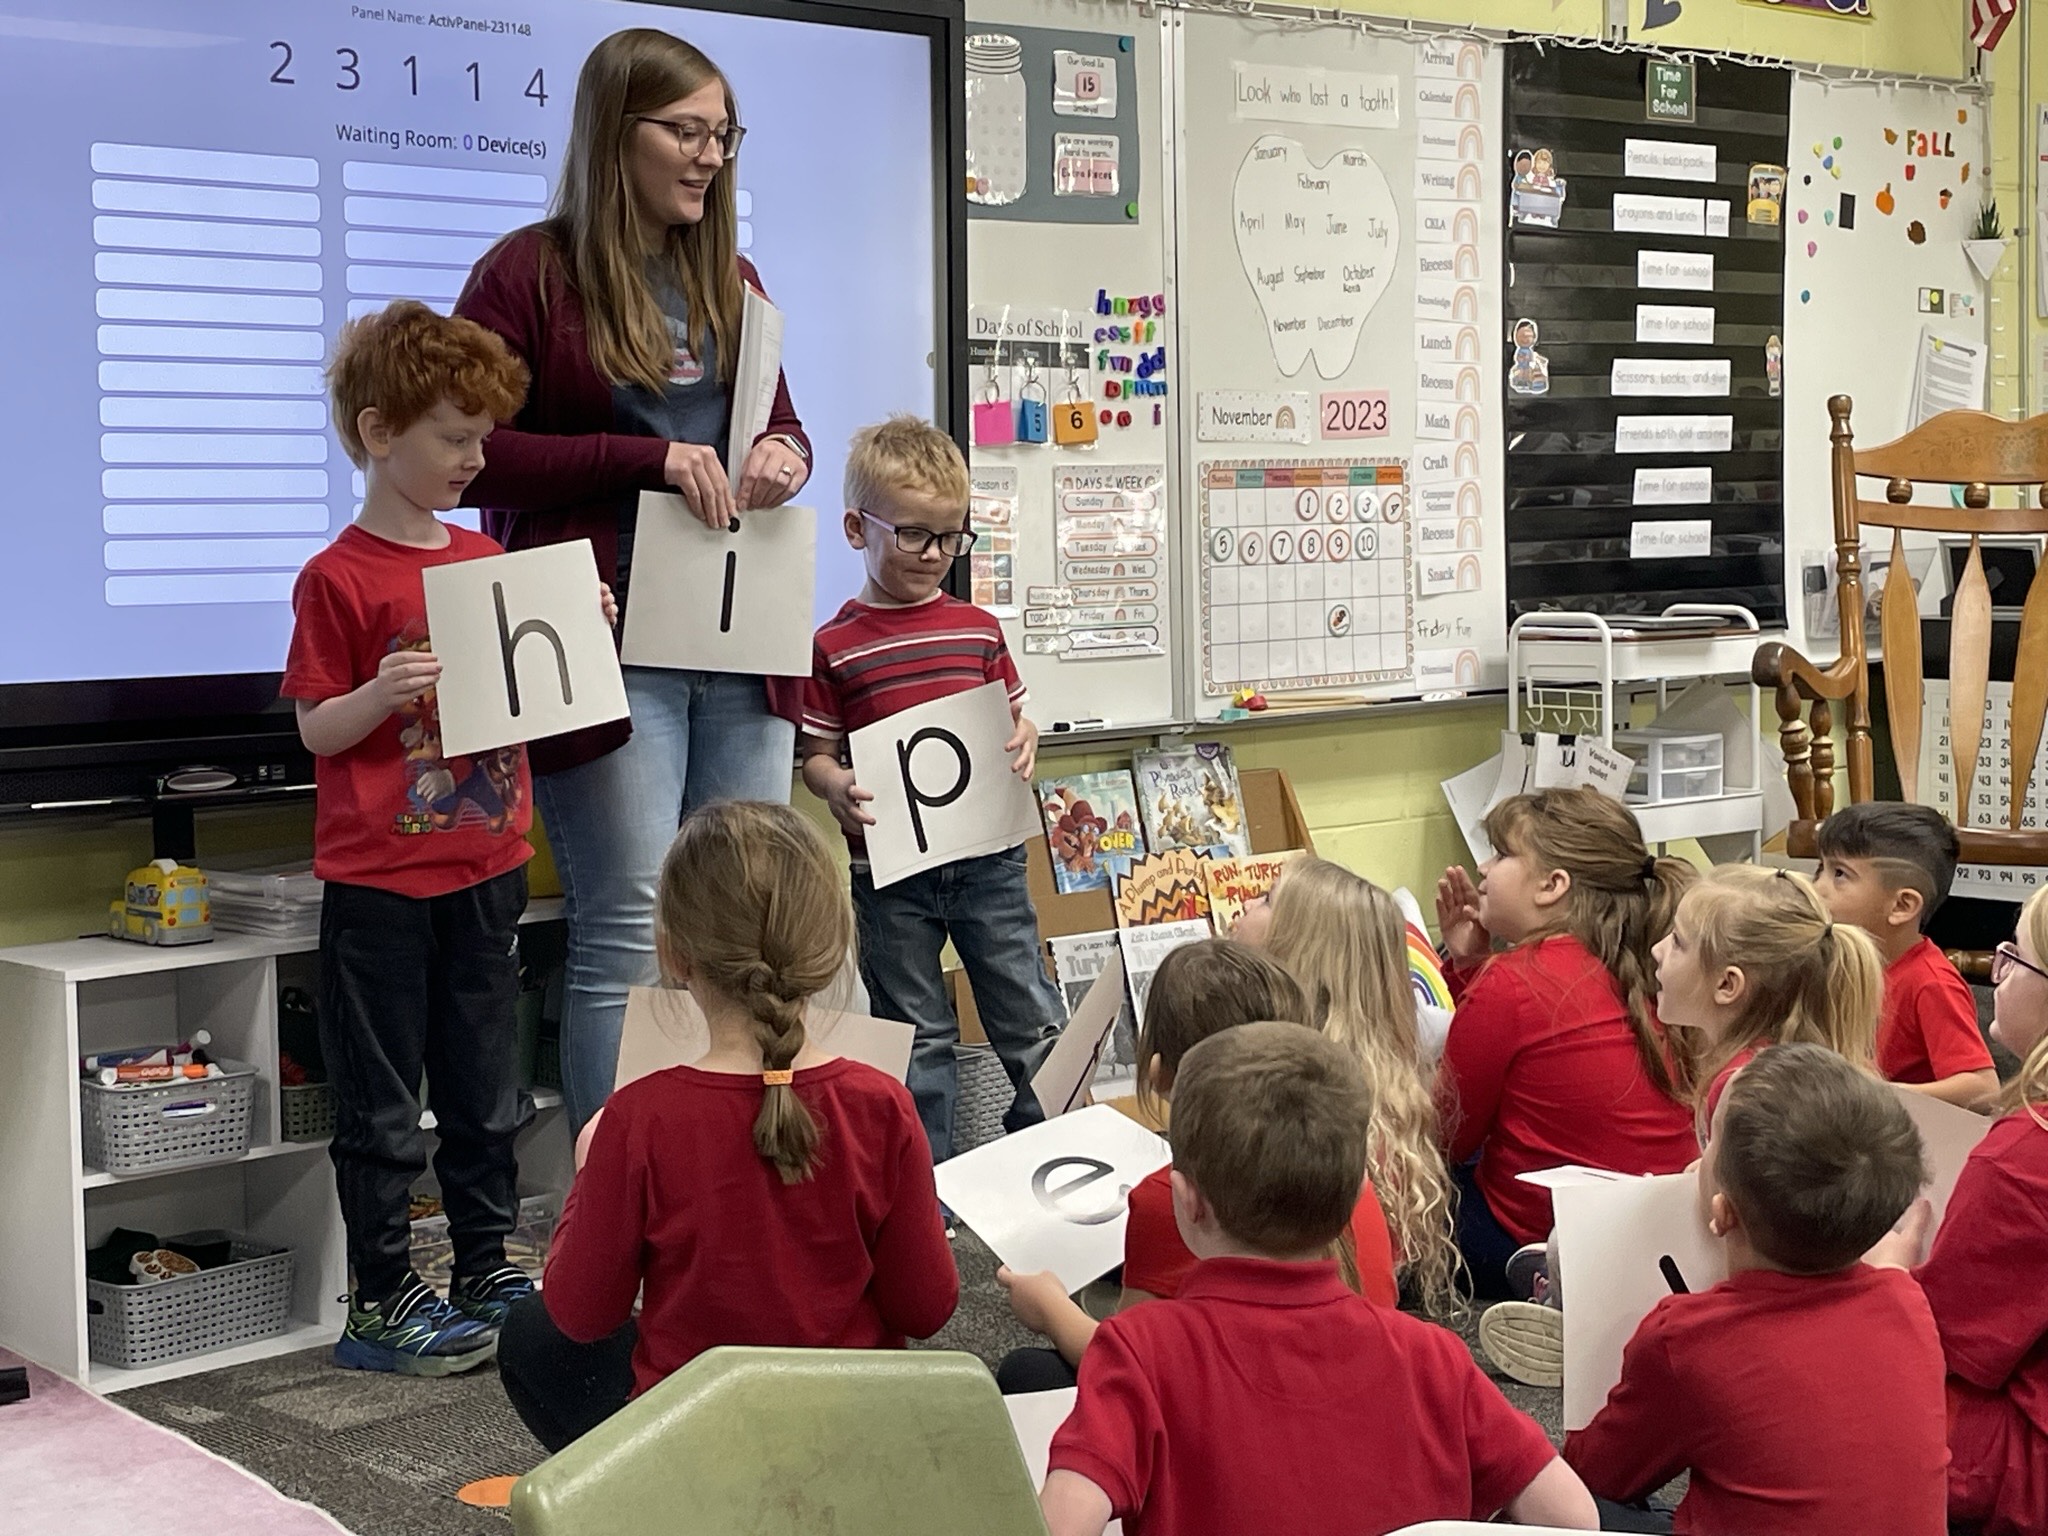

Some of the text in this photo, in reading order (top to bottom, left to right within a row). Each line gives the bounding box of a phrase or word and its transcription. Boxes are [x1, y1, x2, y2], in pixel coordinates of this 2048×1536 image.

[352, 5, 532, 37] Panel Name: ActivPanel-231148
[1423, 52, 1455, 66] Arrival
[269, 41, 549, 108] 2 3 1 1 4
[1656, 66, 1682, 83] Time
[1082, 76, 1096, 93] 15
[1238, 72, 1394, 111] Look who lost a tooth!
[1660, 84, 1678, 100] For
[1652, 99, 1688, 116] School
[336, 124, 548, 160] Waiting Room: 0 Device(s)
[1254, 146, 1368, 167] January March
[1422, 174, 1456, 190] Writing
[1240, 211, 1389, 248] April May June July
[1257, 266, 1285, 292] August
[1017, 318, 1032, 336] of
[1273, 315, 1354, 334] November December
[1421, 335, 1452, 350] Lunch
[1070, 411, 1084, 430] 6
[1212, 399, 1387, 431] November 2023
[1425, 414, 1450, 429] Math
[1035, 418, 1041, 433] 5
[1423, 456, 1449, 470] Craft
[1075, 476, 1143, 490] DAYS WEEK
[1305, 496, 1312, 514] 1
[1336, 498, 1343, 515] 2
[1362, 497, 1371, 514] 3
[1422, 526, 1455, 541] Recess
[1219, 535, 1374, 557] 5 6 7 8 9 10
[720, 516, 740, 634] i
[1428, 566, 1455, 582] Snack
[491, 581, 573, 718] h
[1939, 735, 1991, 748] 21 23
[1589, 747, 1610, 767] Voice
[1939, 754, 1991, 768] 31 33
[1938, 772, 1991, 786] 41 43
[896, 726, 973, 854] p
[1939, 791, 1949, 802] 51
[1978, 794, 1992, 805] 53
[1977, 813, 2036, 827] 63 65
[1099, 831, 1136, 851] OVER
[1124, 873, 1157, 904] Plump
[1156, 857, 1174, 879] and
[1956, 867, 1969, 879] 92
[1977, 869, 1991, 880] 93
[2000, 871, 2013, 882] 94
[2022, 873, 2036, 884] 95
[1066, 951, 1106, 977] Turk
[1031, 1156, 1132, 1226] e
